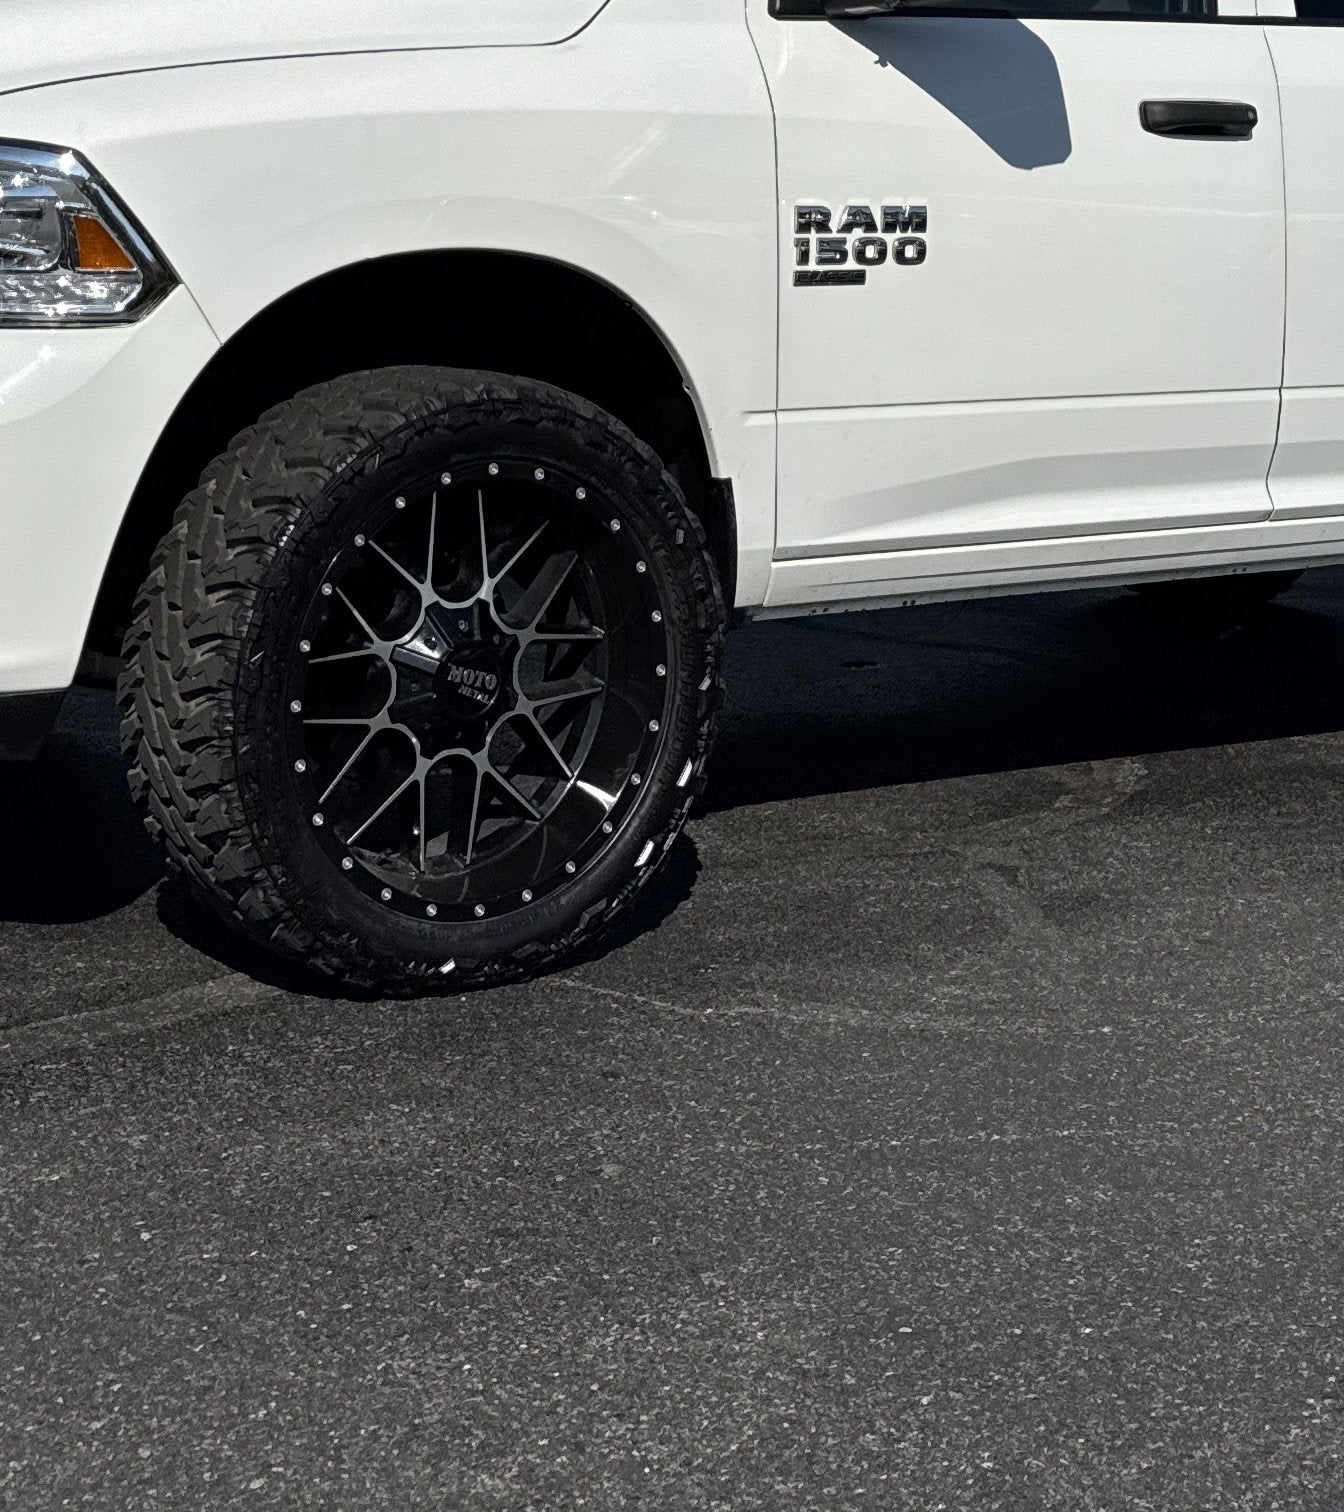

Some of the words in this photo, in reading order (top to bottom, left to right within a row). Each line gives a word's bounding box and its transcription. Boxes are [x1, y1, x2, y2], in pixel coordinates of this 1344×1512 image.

[795, 206, 928, 234] RAM
[795, 237, 927, 266] 1500
[447, 662, 497, 690] MOTO
